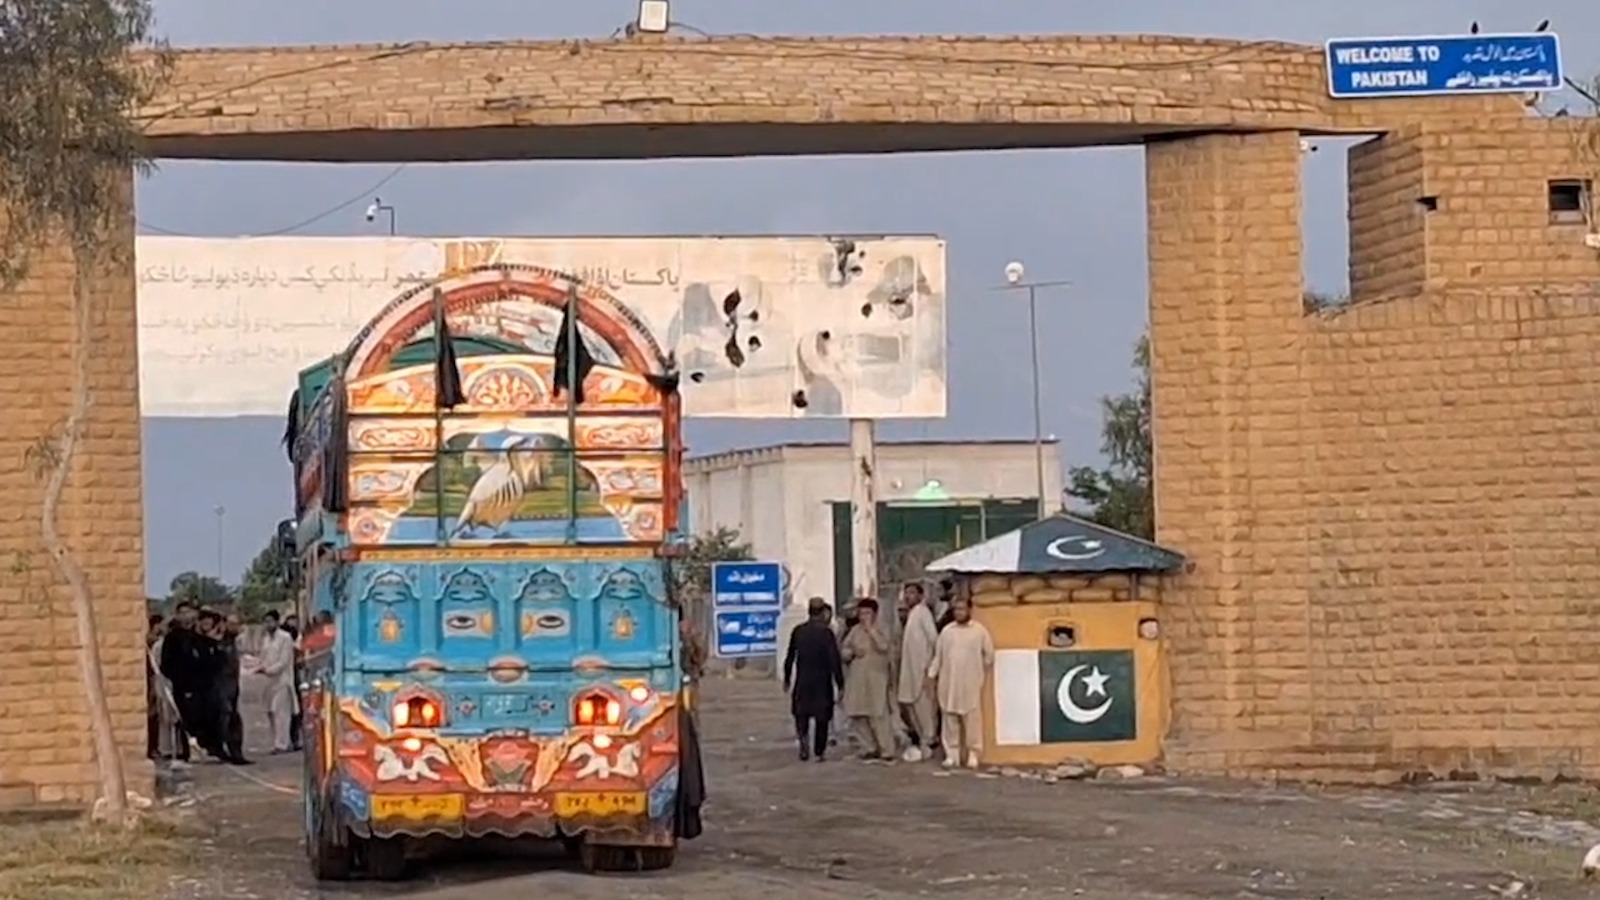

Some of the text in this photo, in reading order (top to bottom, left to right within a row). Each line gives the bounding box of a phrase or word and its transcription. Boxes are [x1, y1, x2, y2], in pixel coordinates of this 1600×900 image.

[1335, 46, 1440, 65] WELCOME TO
[1351, 70, 1428, 88] PAKISTAN
